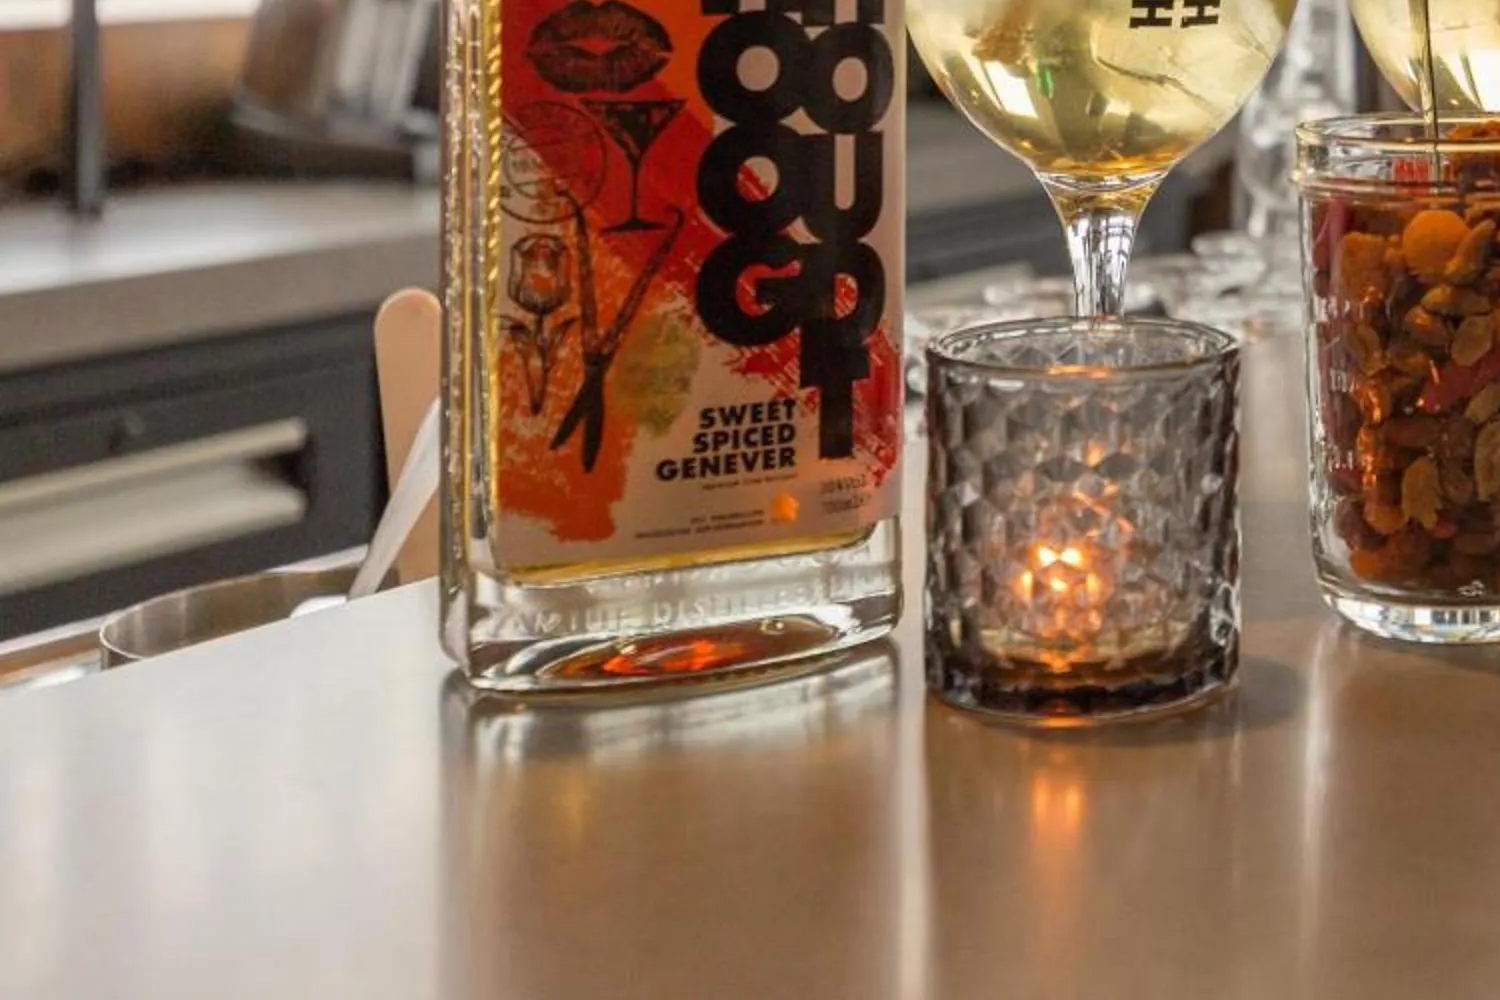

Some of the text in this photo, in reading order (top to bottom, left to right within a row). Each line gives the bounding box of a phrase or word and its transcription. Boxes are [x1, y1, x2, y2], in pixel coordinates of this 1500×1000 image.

[699, 399, 797, 429] SWEET
[692, 424, 796, 453] SPICED
[656, 447, 797, 481] GENEVER
